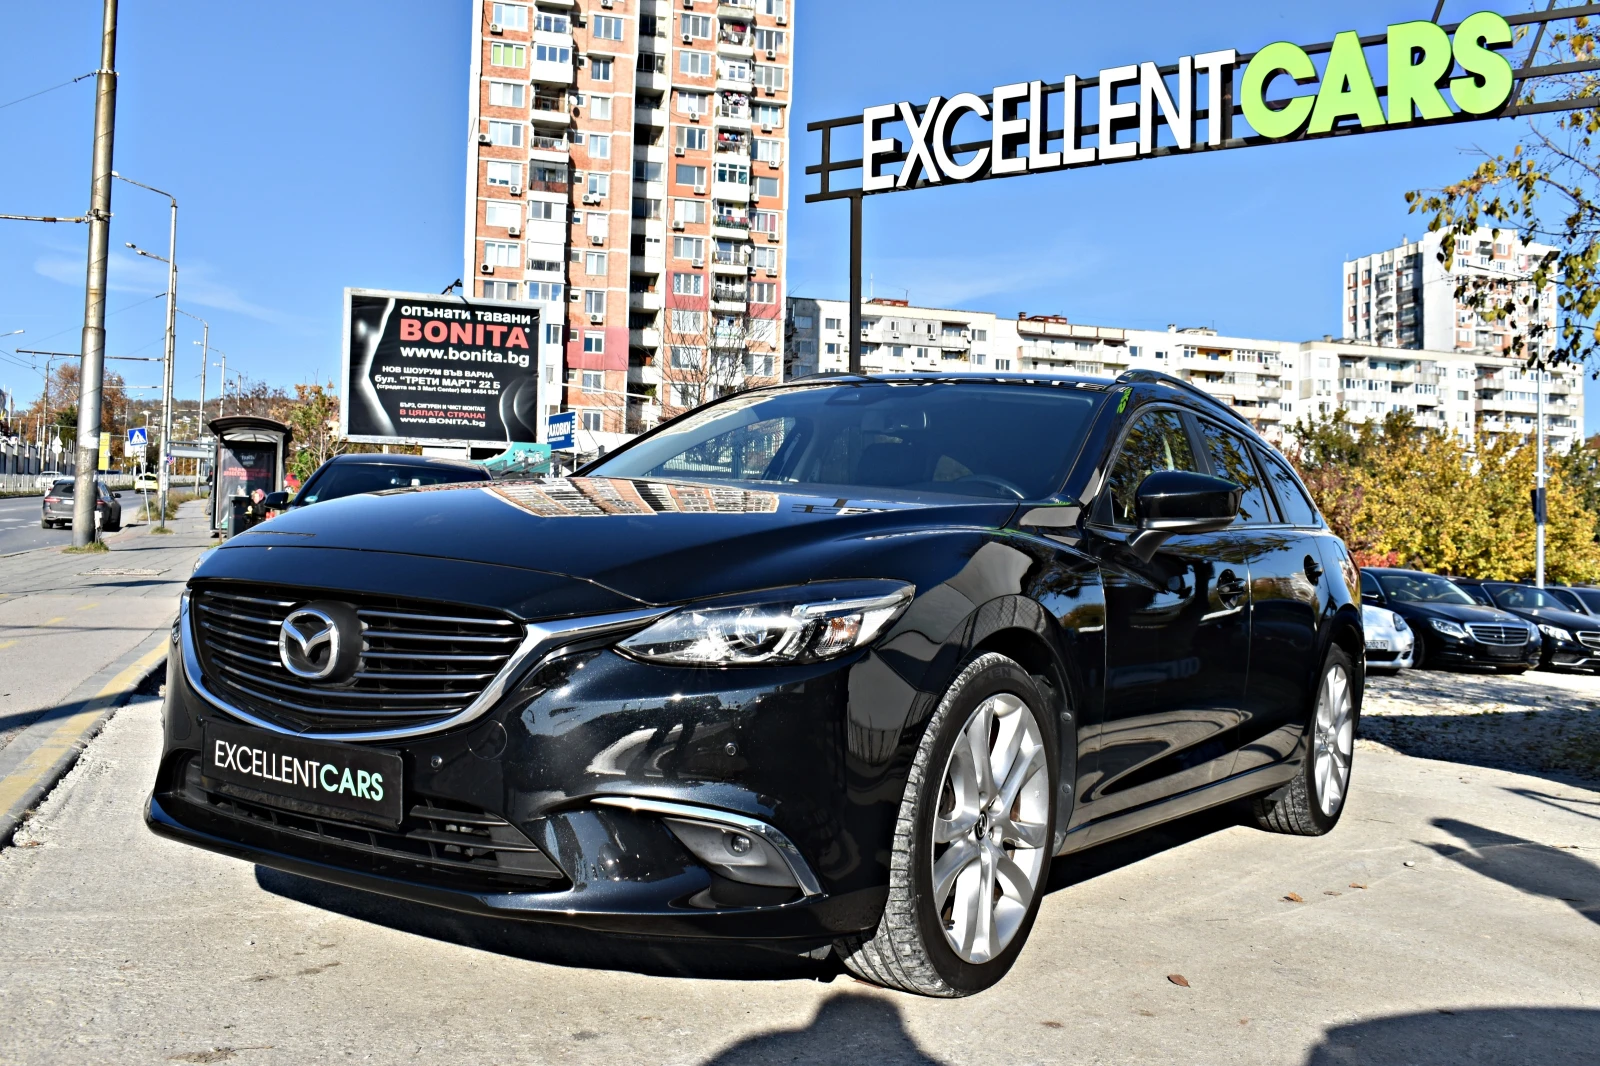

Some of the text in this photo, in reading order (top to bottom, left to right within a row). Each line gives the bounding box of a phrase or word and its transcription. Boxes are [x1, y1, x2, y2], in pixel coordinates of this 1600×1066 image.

[401, 305, 531, 325] опънати тавани
[400, 347, 530, 368] www.bonita.bg
[382, 365, 495, 379] НОВ ШОУРУМ ВЪВ ВАРНА
[374, 374, 398, 385] бул.
[478, 380, 492, 389] 22
[492, 381, 501, 390] Б
[399, 408, 486, 419] В ЦЯЛАТА СТРАНА!
[399, 416, 486, 428] www.BONITA.bg
